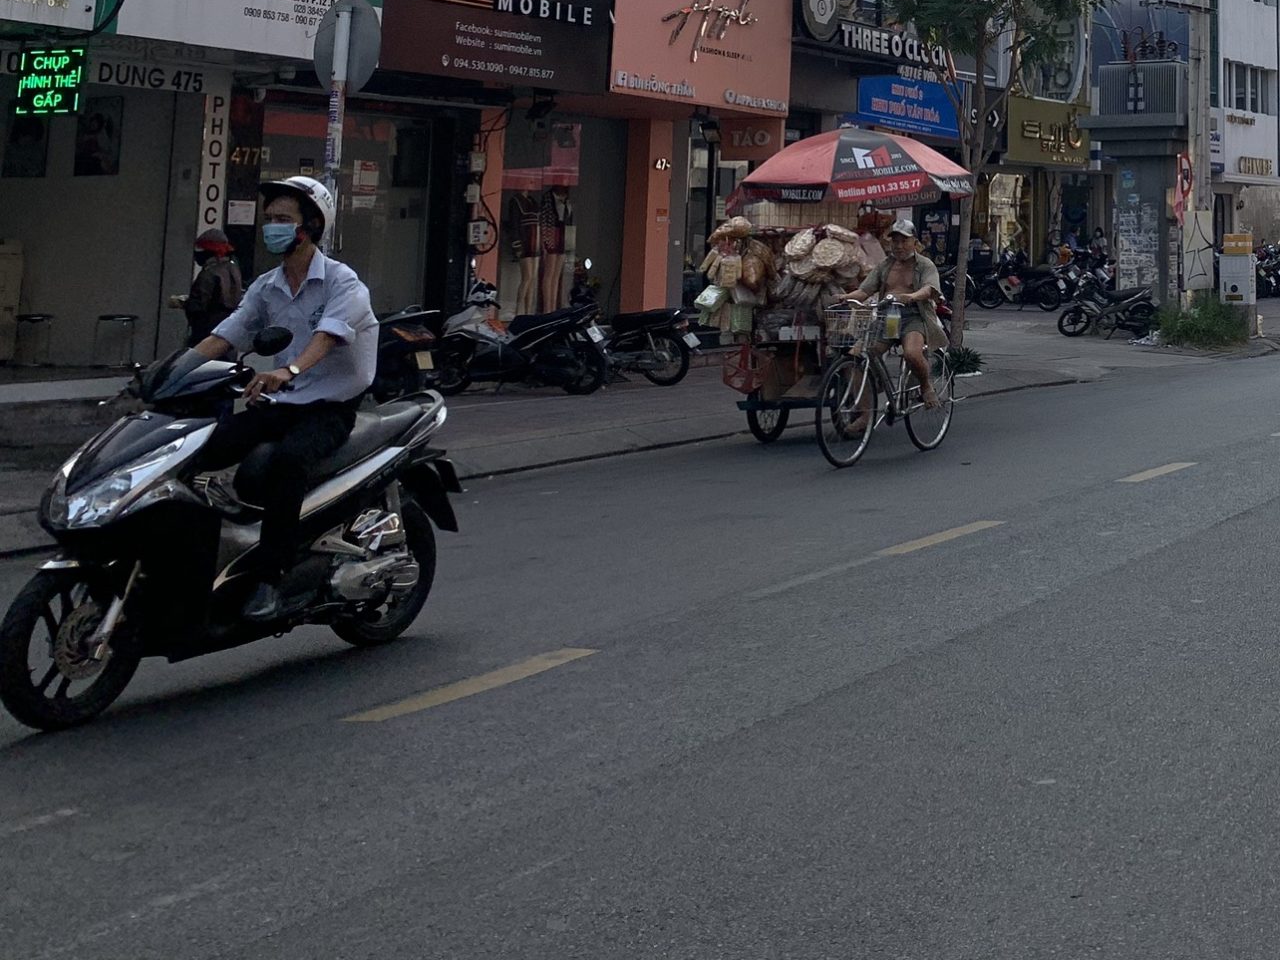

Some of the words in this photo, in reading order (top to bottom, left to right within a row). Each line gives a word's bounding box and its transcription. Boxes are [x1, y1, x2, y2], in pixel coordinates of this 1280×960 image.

[243, 7, 261, 18] 0909
[263, 9, 275, 20] 853
[294, 4, 306, 14] 028
[456, 35, 485, 48] Website
[841, 22, 889, 57] THREE
[33, 55, 70, 73] CHỤP
[54, 70, 77, 88] THẺ
[171, 70, 203, 93] 475
[33, 91, 62, 108] GẤP
[838, 187, 866, 198] Hotline
[867, 182, 898, 194] 0911.33
[900, 181, 910, 190] 55
[911, 178, 921, 188] 77
